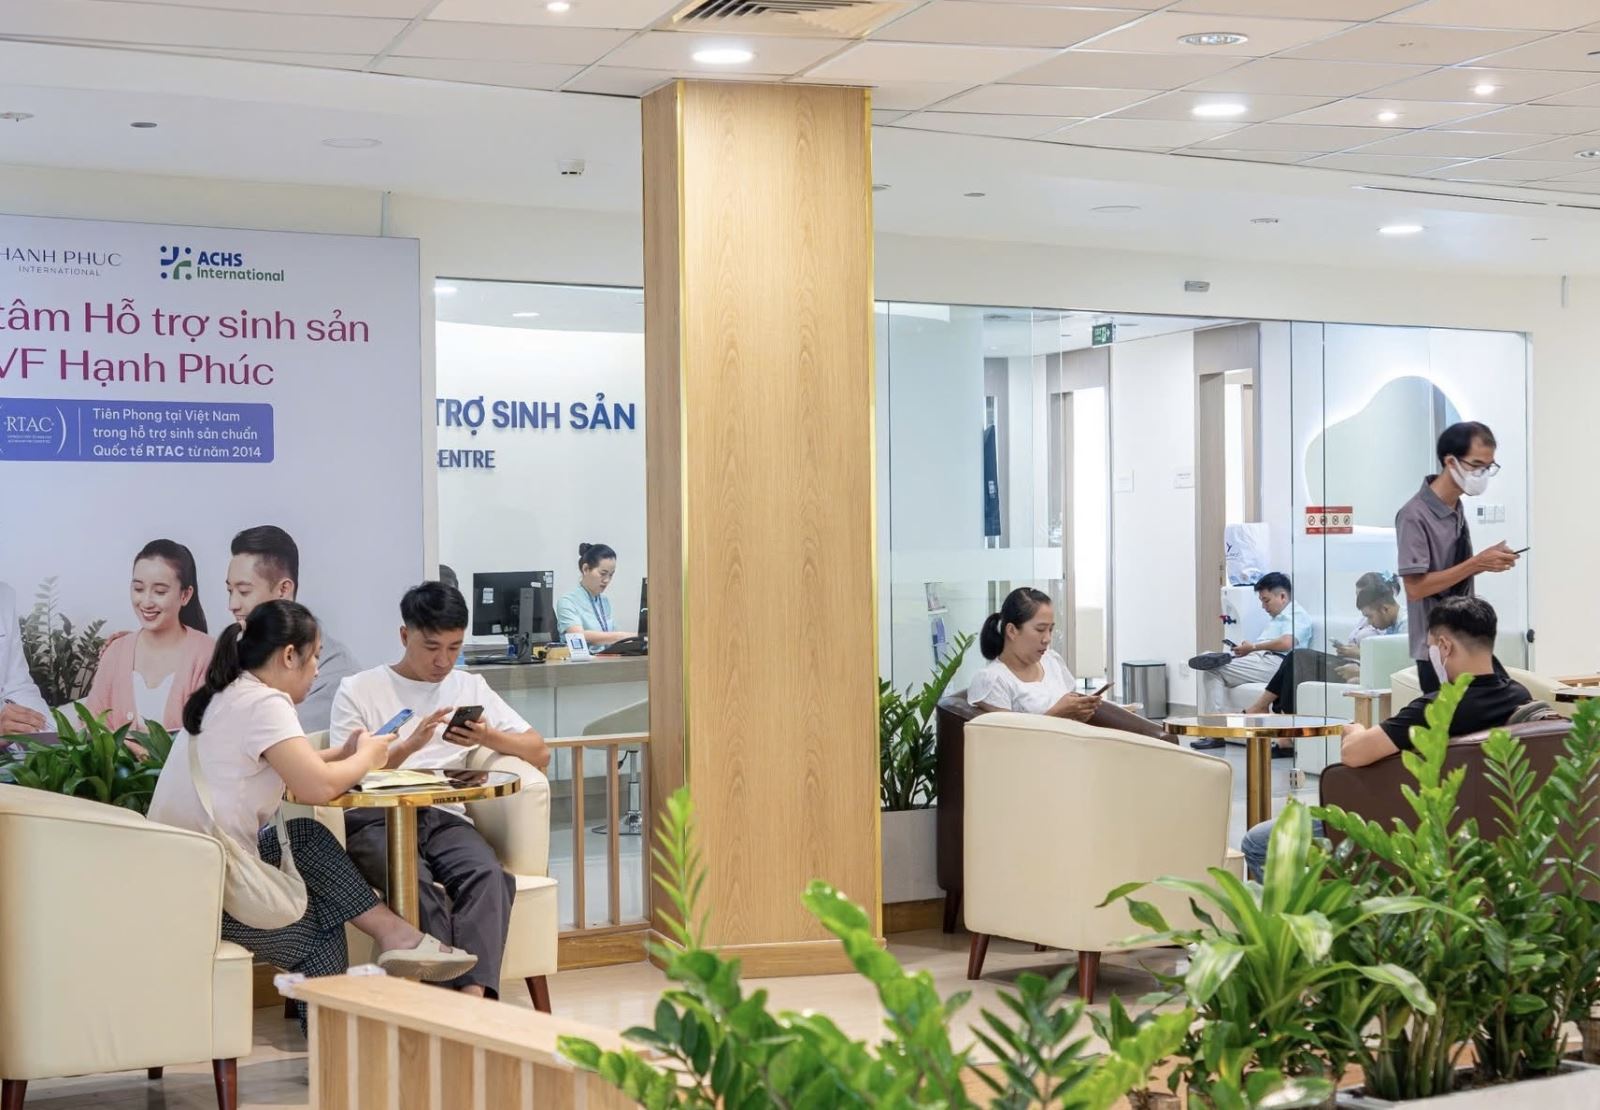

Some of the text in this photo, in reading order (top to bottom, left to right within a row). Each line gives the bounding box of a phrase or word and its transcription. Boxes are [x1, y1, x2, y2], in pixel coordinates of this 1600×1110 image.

[0, 247, 122, 266] HANH PHUC
[197, 251, 243, 267] ACHS
[19, 265, 101, 277] INTERNATIONAL
[197, 267, 285, 281] International
[85, 298, 140, 335] Hỗ
[152, 308, 210, 343] trợ
[218, 309, 296, 341] sinh
[306, 308, 370, 342] sản
[60, 348, 166, 387] Hạnh
[179, 353, 275, 386] Phúc
[93, 408, 240, 424] Tiên Phong tại Việt Nam
[492, 400, 561, 429] SINH
[569, 392, 636, 430] SẢN
[6, 416, 53, 432] RTAC
[93, 425, 258, 442] trong hỗ trợ sinh sản chuẩn
[93, 443, 262, 458] Quốc tế RTAC từ năm 2014
[437, 449, 496, 469] ENTRE
